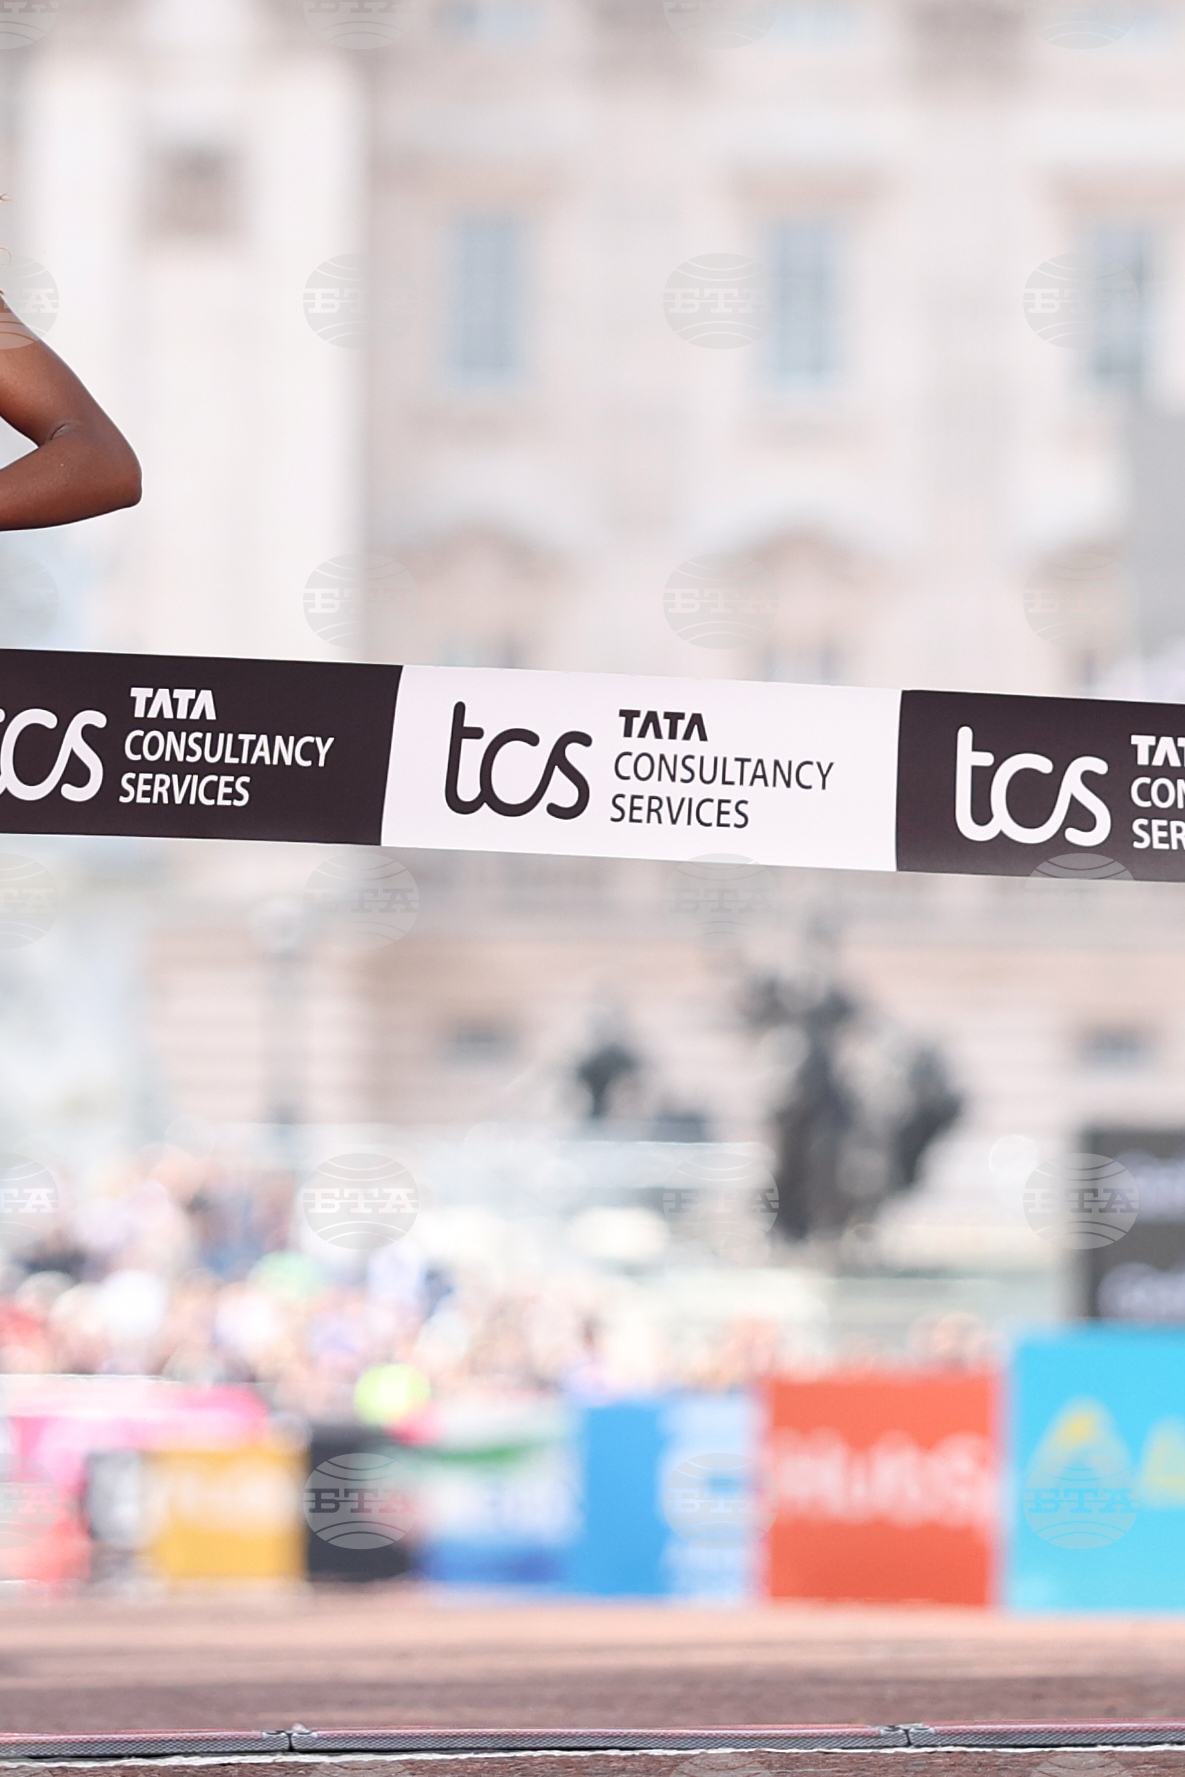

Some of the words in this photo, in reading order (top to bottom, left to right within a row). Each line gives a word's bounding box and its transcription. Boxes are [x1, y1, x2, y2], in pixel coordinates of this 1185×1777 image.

[130, 687, 217, 720] TATA
[618, 708, 709, 742] TATA
[123, 729, 335, 767] CONSULTANCY
[444, 701, 593, 820] tcs
[119, 772, 251, 807] SERVICES
[614, 751, 835, 791] CONSULTANCY
[954, 726, 1112, 847] tcs
[609, 793, 750, 829] SERVICES
